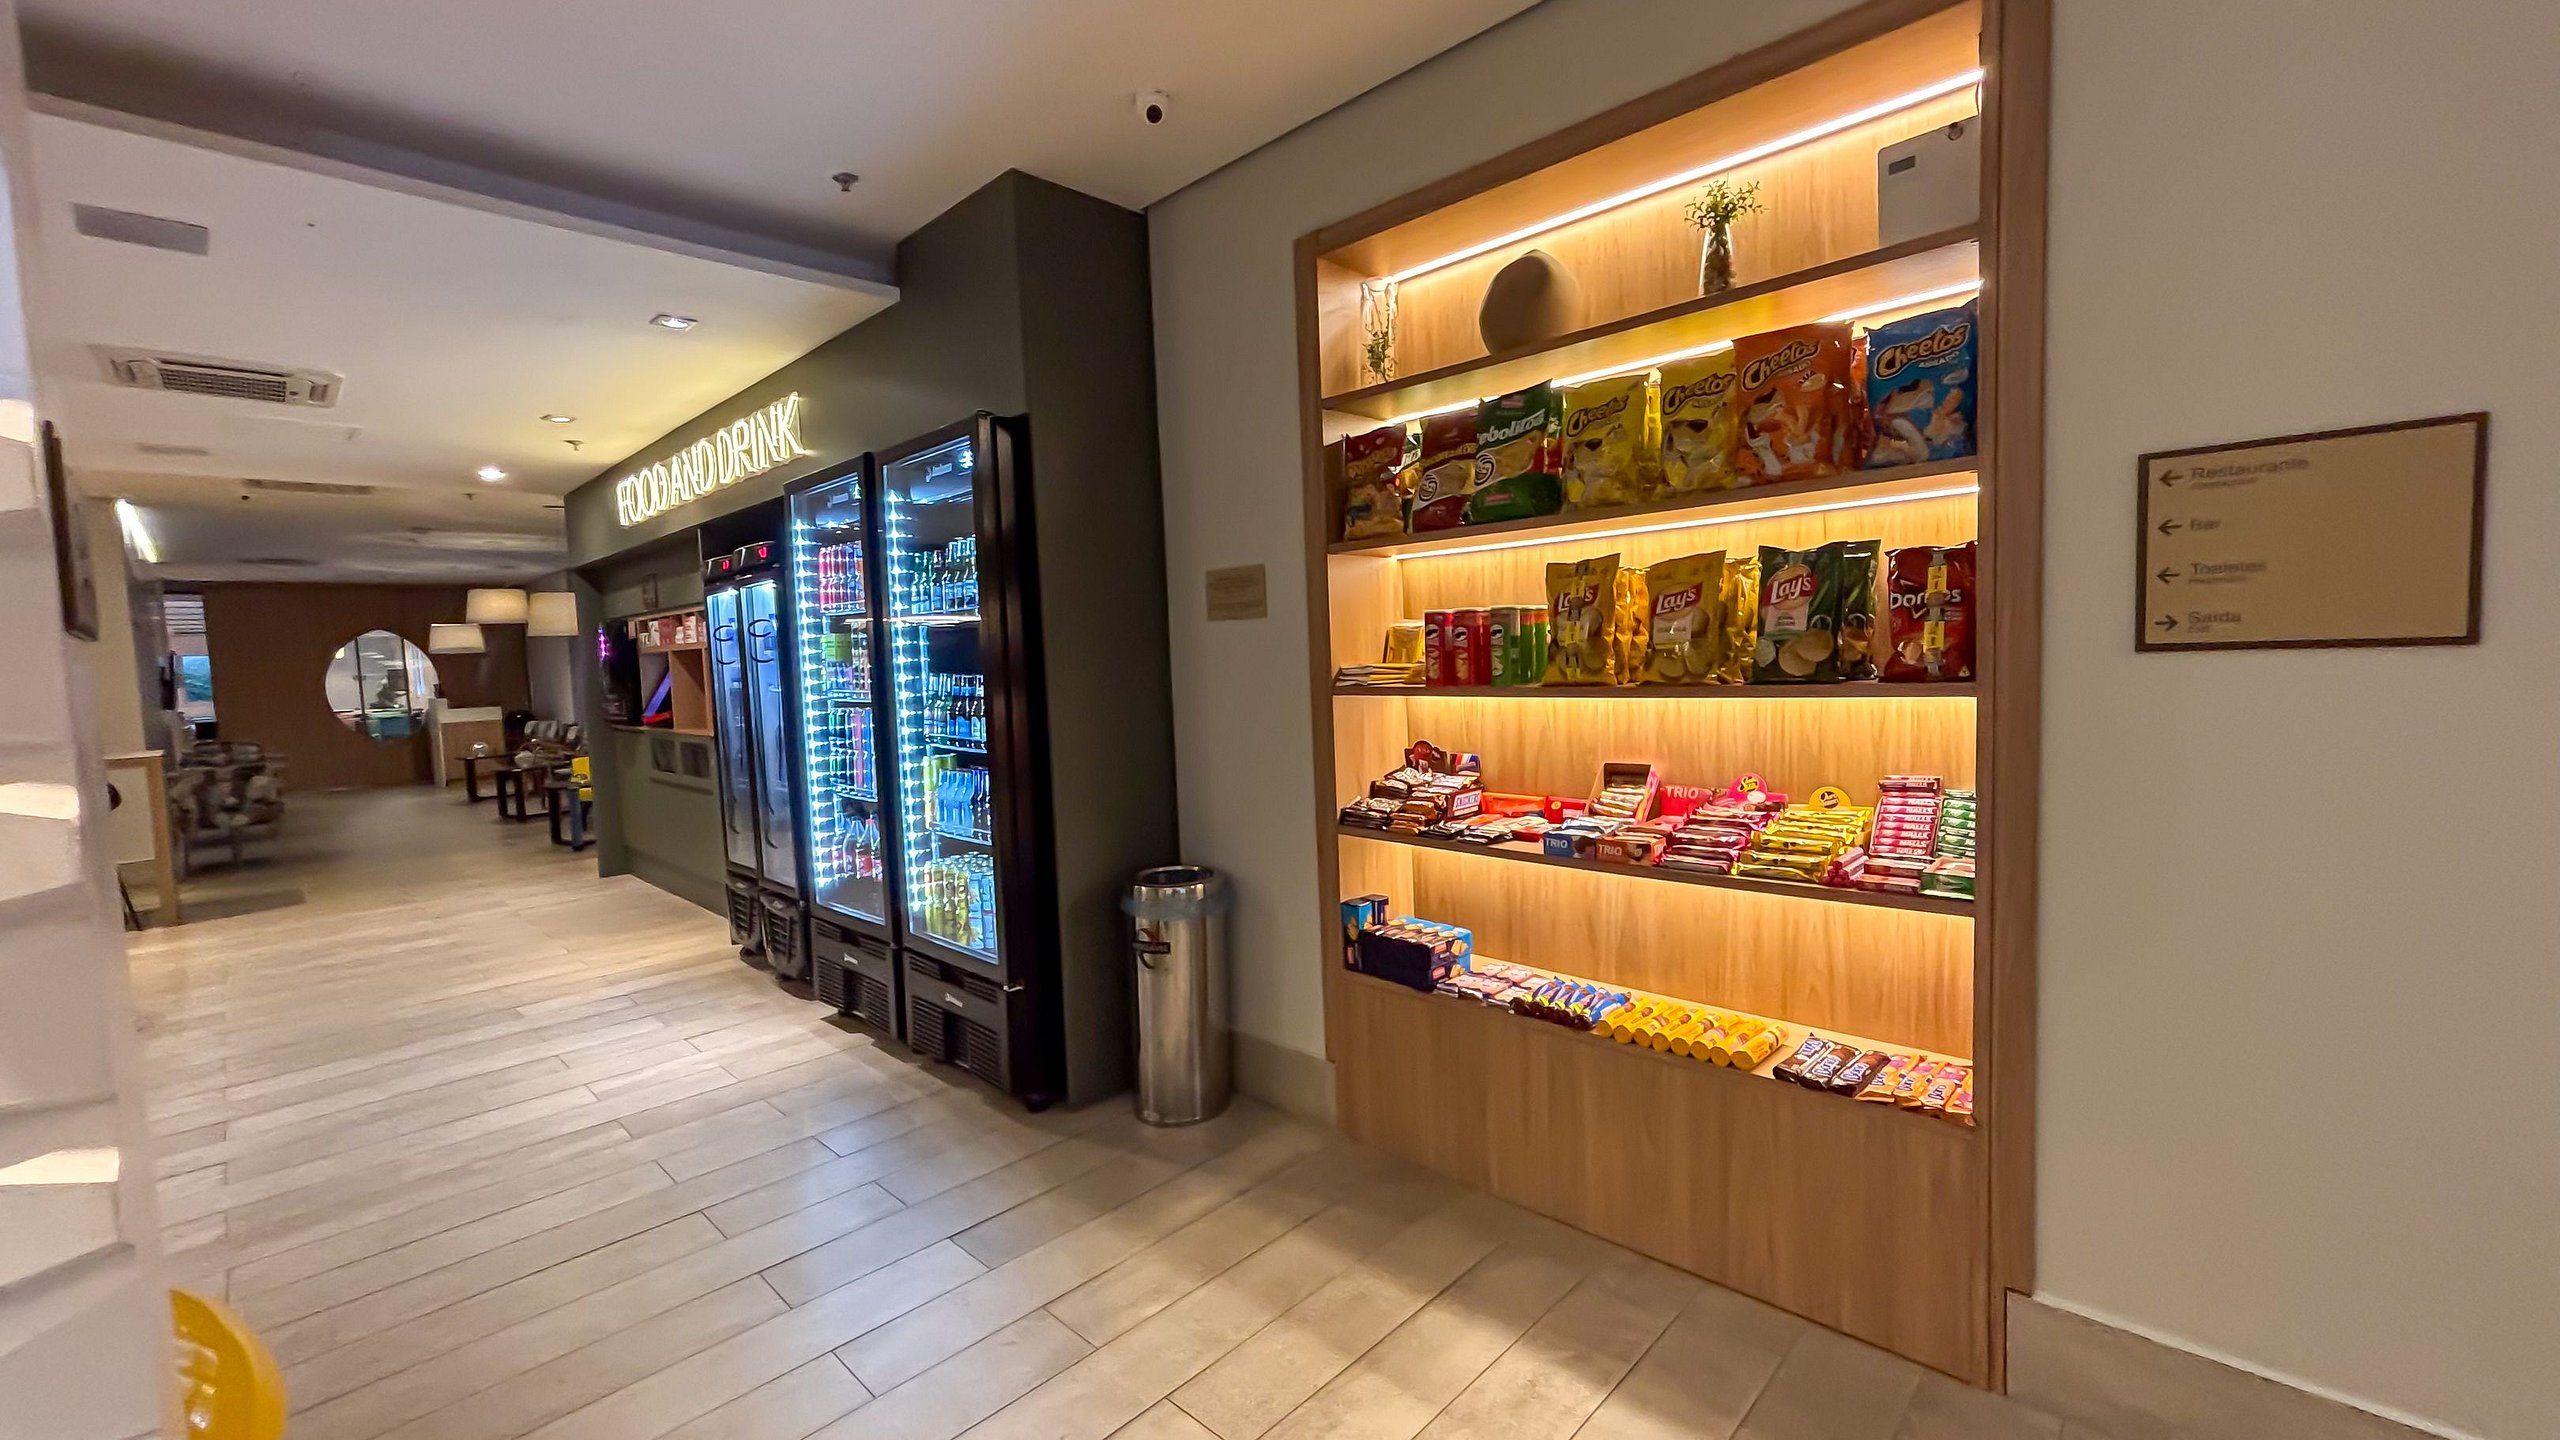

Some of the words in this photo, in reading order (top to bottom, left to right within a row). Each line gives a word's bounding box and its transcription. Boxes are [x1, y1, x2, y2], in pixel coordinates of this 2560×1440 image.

[1742, 339, 1820, 391] Cheetos
[1876, 323, 1970, 378] Cheetos
[1477, 408, 1545, 445] ebolitos
[616, 462, 671, 526] FOOD
[670, 437, 717, 505] AND
[716, 392, 806, 485] DRINK
[1656, 587, 1697, 614] Lay's
[1770, 573, 1812, 604] Lay's
[1666, 785, 1699, 799] TRIO
[1546, 837, 1568, 849] TRIO
[1599, 843, 1622, 856] TRIO
